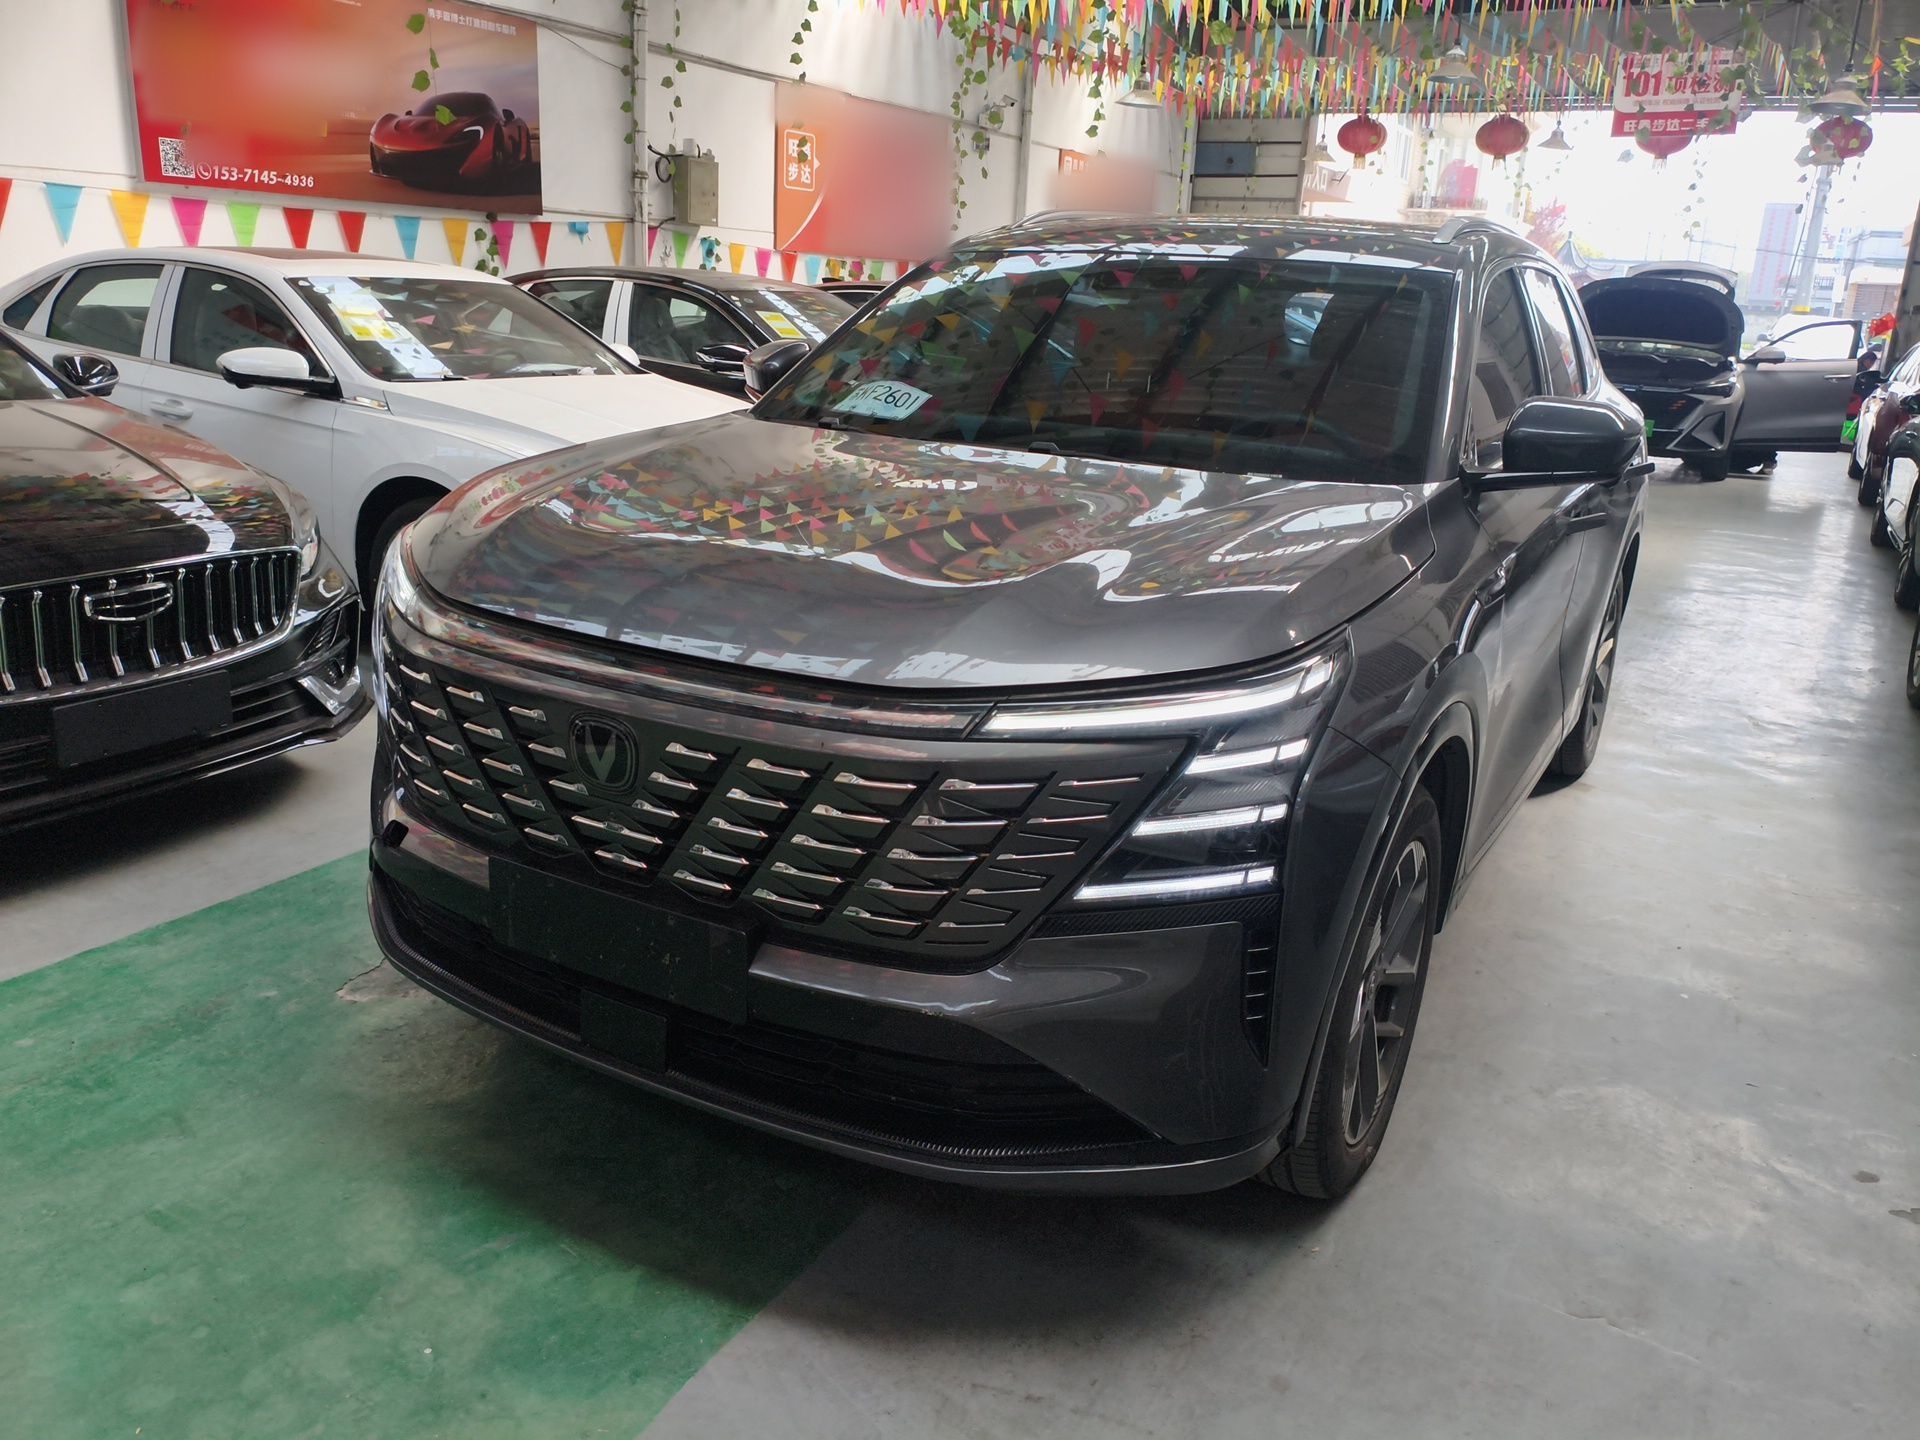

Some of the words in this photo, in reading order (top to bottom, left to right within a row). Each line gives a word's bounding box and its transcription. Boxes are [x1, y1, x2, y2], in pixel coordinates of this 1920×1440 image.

[1623, 117, 1722, 132] 旺步达二手
[212, 165, 314, 188] 153-7145-4936
[788, 162, 811, 184] 步达
